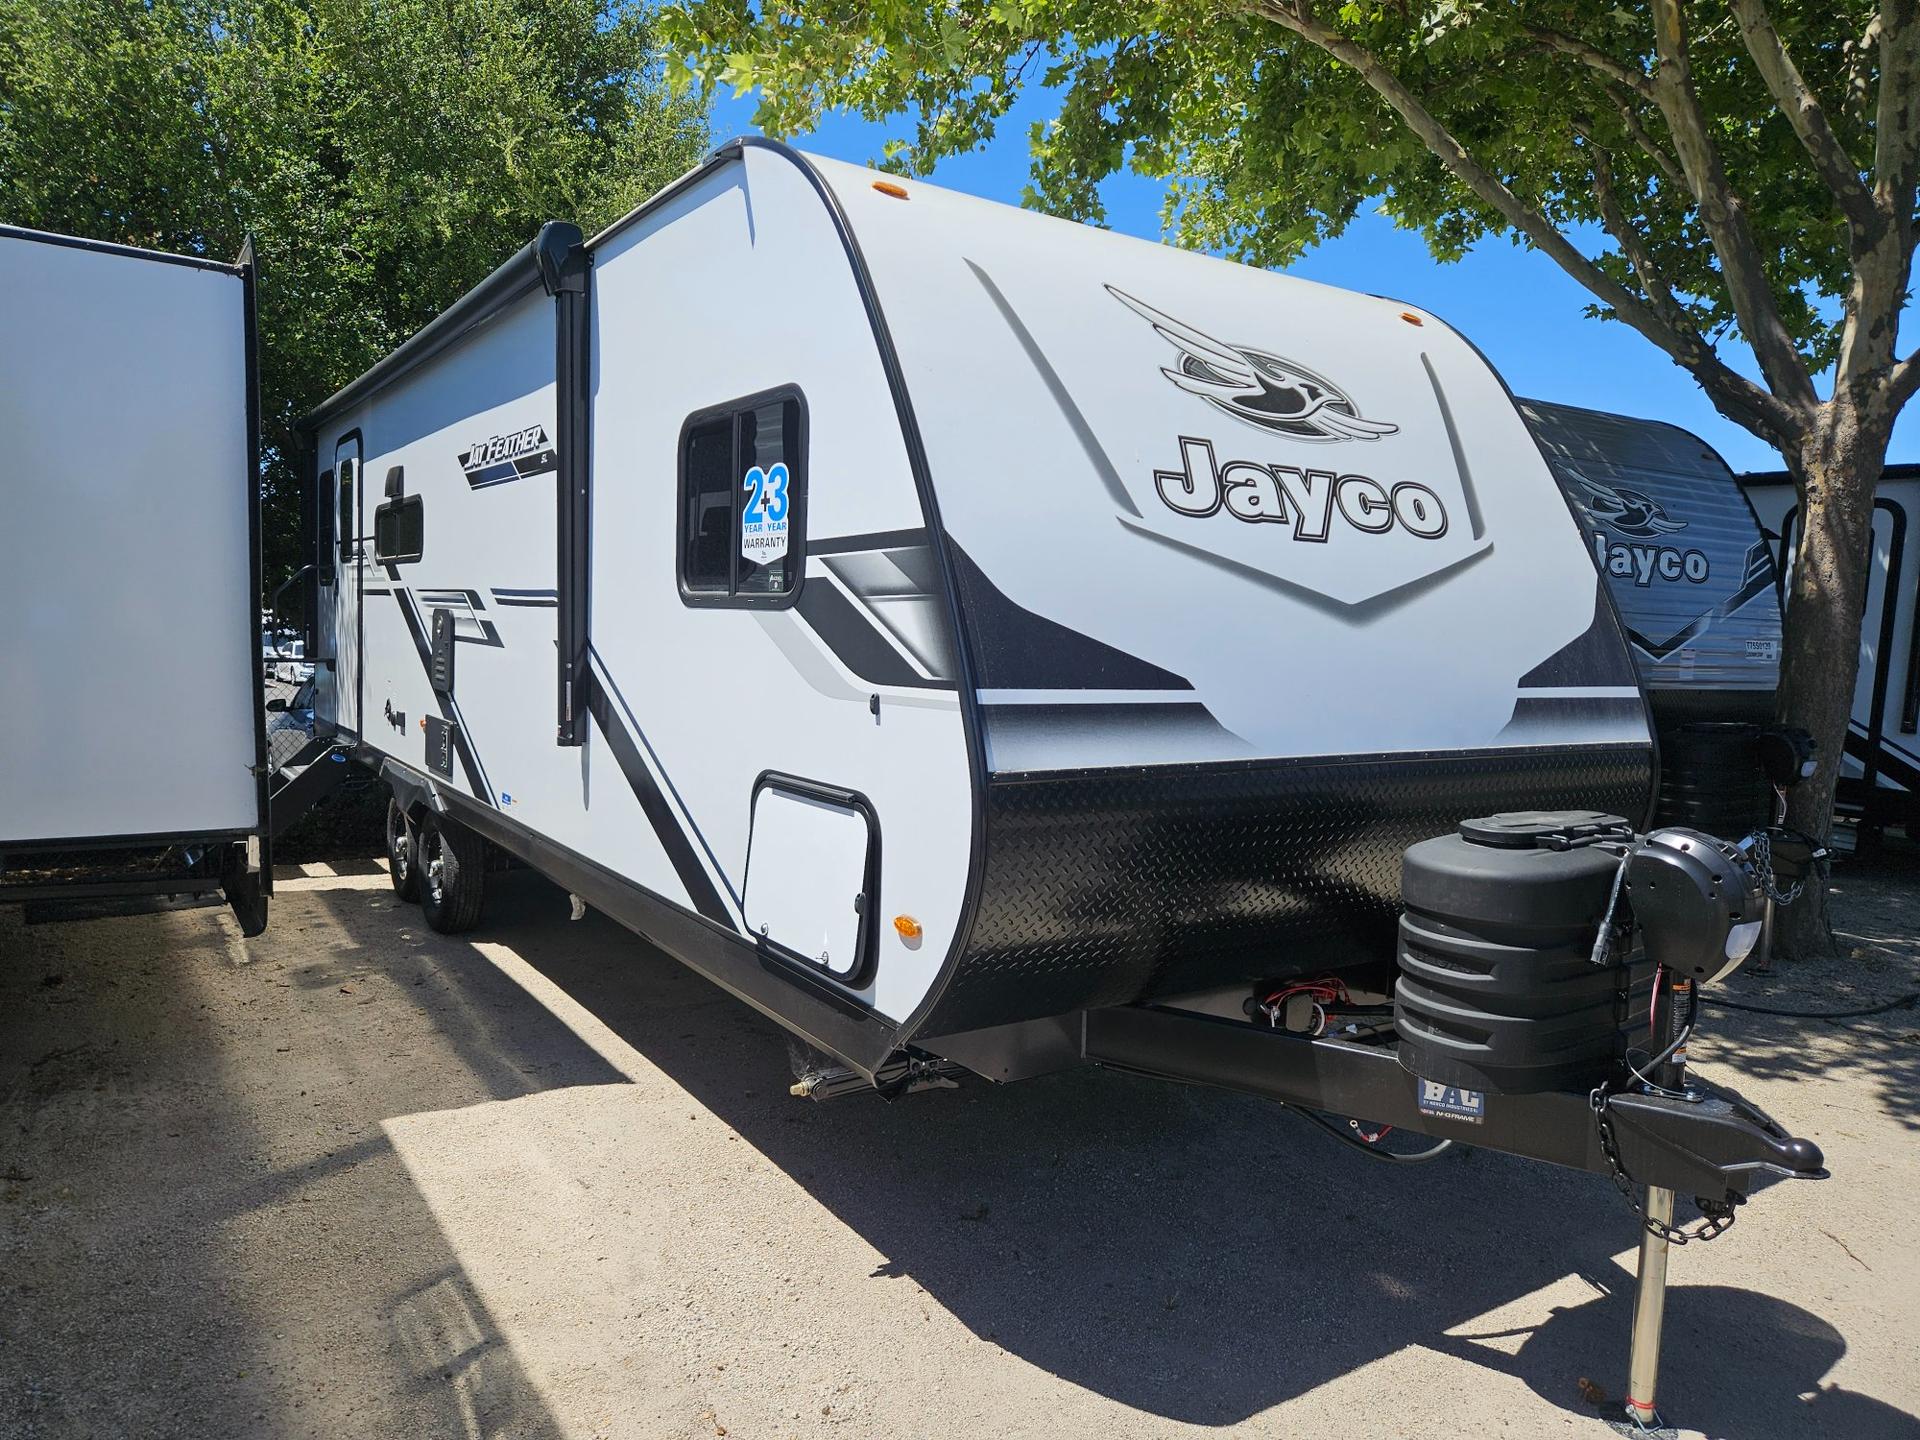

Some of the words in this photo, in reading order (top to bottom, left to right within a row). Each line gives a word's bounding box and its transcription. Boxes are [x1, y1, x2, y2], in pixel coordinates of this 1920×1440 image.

[464, 443, 487, 469] JAY
[488, 424, 542, 462] FEATHER
[1153, 435, 1449, 544] Jayco
[745, 524, 763, 533] YEAR
[767, 522, 787, 532] YEAR
[744, 536, 786, 549] WARRANTY
[1451, 1114, 1475, 1122] FRAME
